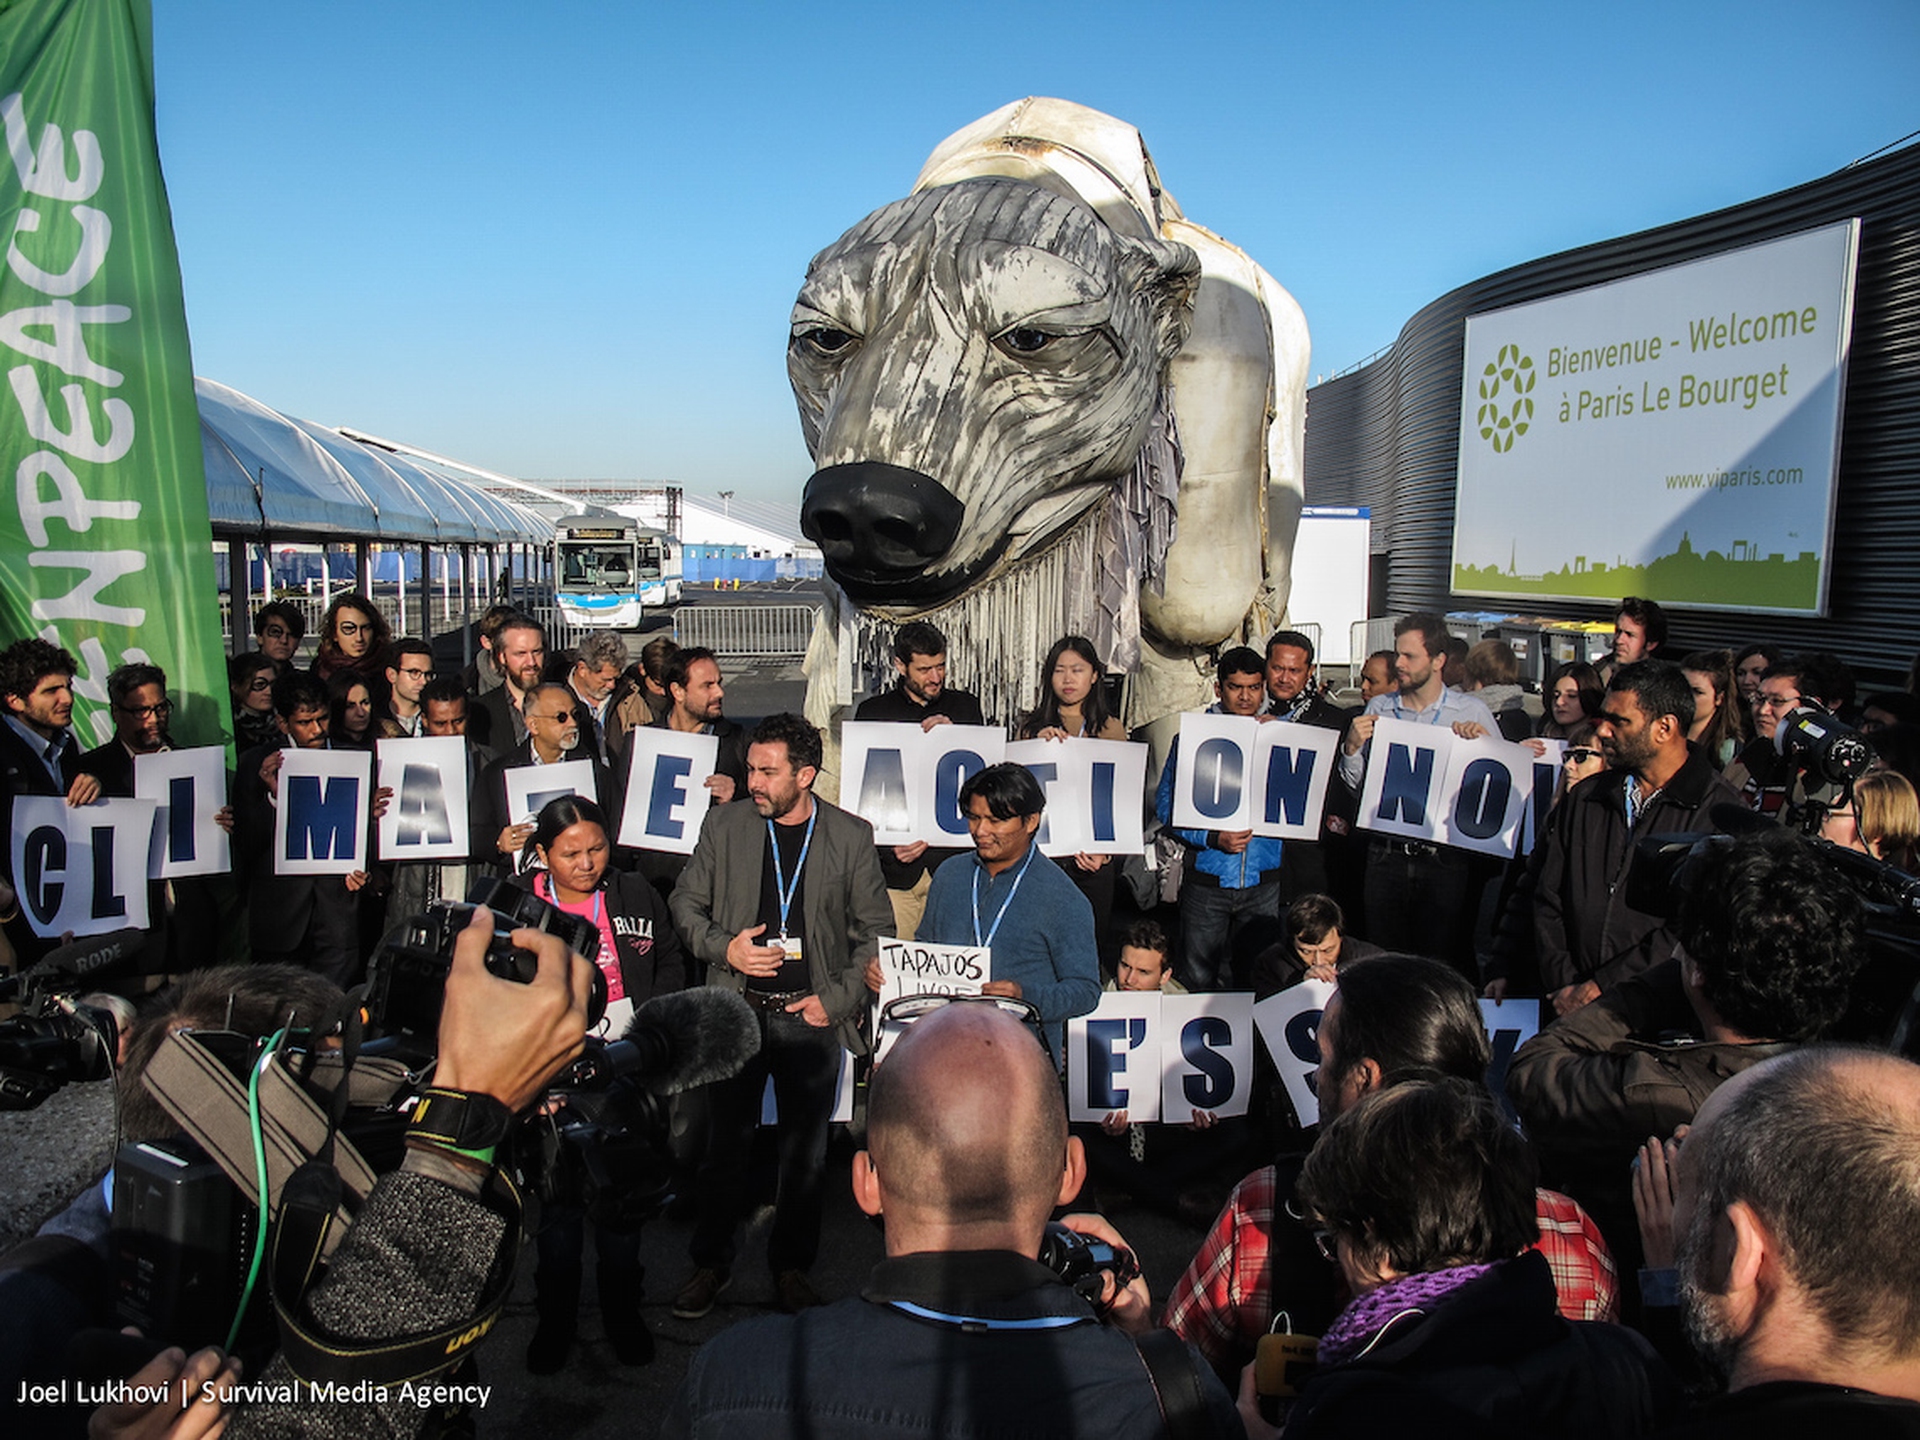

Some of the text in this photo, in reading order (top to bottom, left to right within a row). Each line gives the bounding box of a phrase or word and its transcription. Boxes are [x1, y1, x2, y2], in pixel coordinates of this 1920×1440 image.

[1547, 335, 1662, 378] Bienvenue
[1689, 306, 1817, 353] Welcome
[1559, 363, 1789, 423] à Paris Le Bourget
[1666, 465, 1803, 493] www.viparis.com
